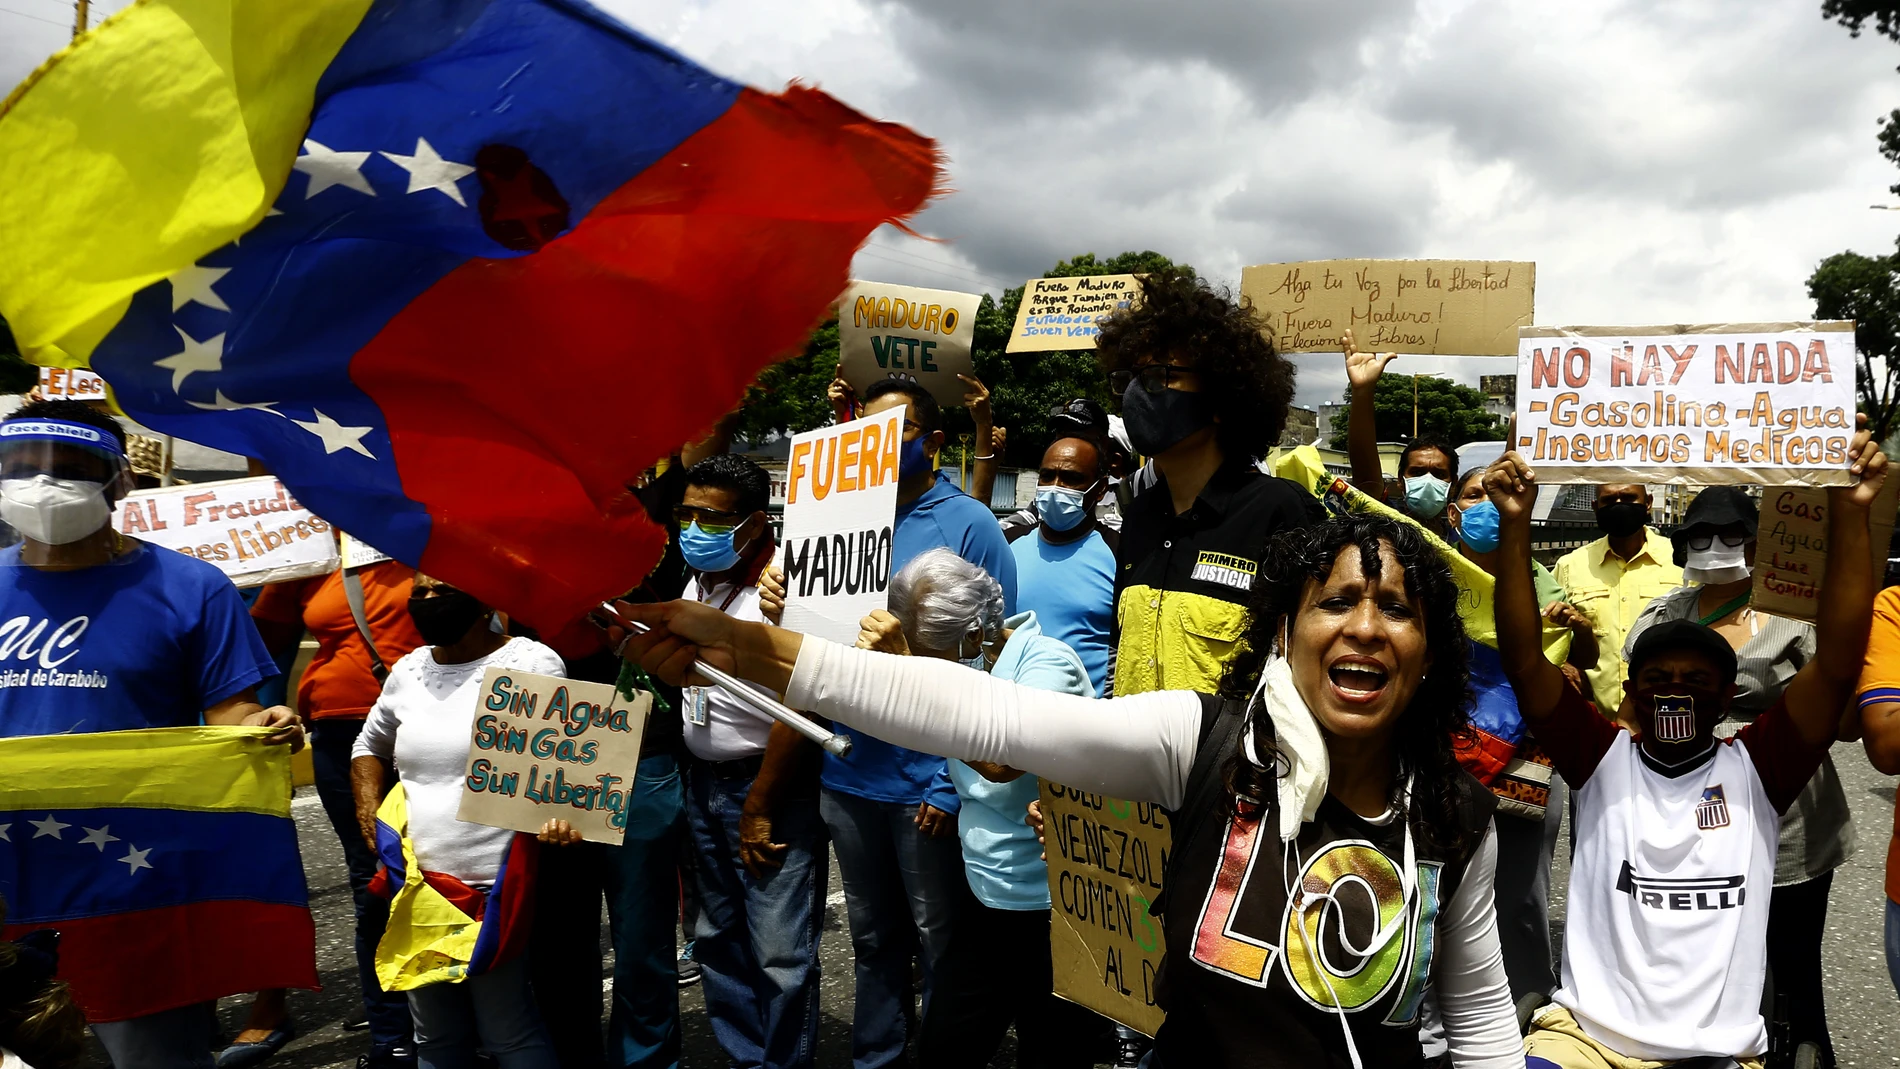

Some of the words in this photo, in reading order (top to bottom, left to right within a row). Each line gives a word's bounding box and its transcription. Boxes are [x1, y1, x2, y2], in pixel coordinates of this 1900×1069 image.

[1323, 268, 1343, 290] tu
[1356, 267, 1380, 302] Voz
[1398, 273, 1418, 297] por
[1426, 267, 1441, 288] la
[1448, 266, 1511, 293] Libertad
[854, 296, 959, 335] MADURO
[1067, 326, 1103, 337] Vene
[871, 336, 938, 372] VETE
[1531, 346, 1591, 389] NO
[1610, 344, 1699, 388] HAY
[1715, 339, 1833, 385] NADA
[8, 425, 40, 433] Face
[45, 425, 92, 439] Shield
[1529, 391, 1728, 428] -Gasolina
[1736, 391, 1850, 437] -Agua
[787, 417, 898, 504] FUERA
[1519, 427, 1692, 463] -Insumos
[1704, 427, 1847, 465] Medicos
[122, 499, 167, 534] AL
[1776, 491, 1825, 522] Gas
[1770, 521, 1827, 554] Agua
[784, 526, 893, 598] MADURO
[1194, 564, 1252, 591] JUSTICIA
[1199, 552, 1256, 573] PRIMERO
[31, 668, 47, 687] de
[48, 668, 108, 689] Carabobo
[531, 728, 600, 765] Gas
[1060, 870, 1134, 942] COMEN
[1133, 896, 1157, 952] 3
[1105, 945, 1132, 997] AL
